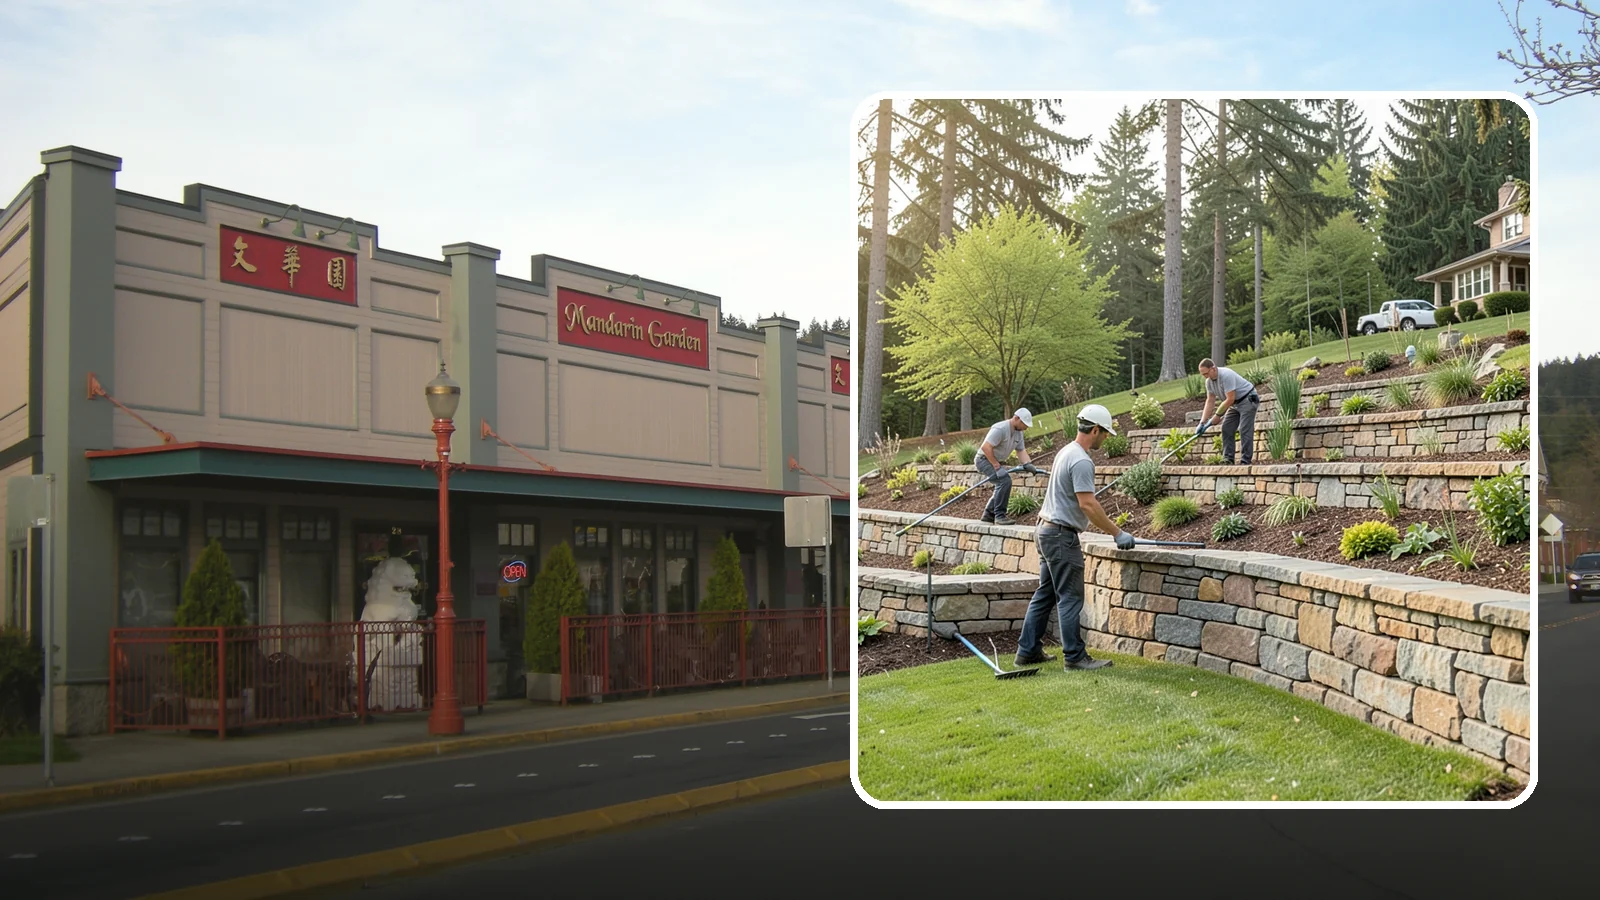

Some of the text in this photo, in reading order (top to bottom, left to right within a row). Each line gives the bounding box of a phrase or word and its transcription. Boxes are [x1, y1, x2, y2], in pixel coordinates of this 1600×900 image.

[564, 302, 702, 352] Mandarin Garden
[503, 565, 527, 578] OPEN
